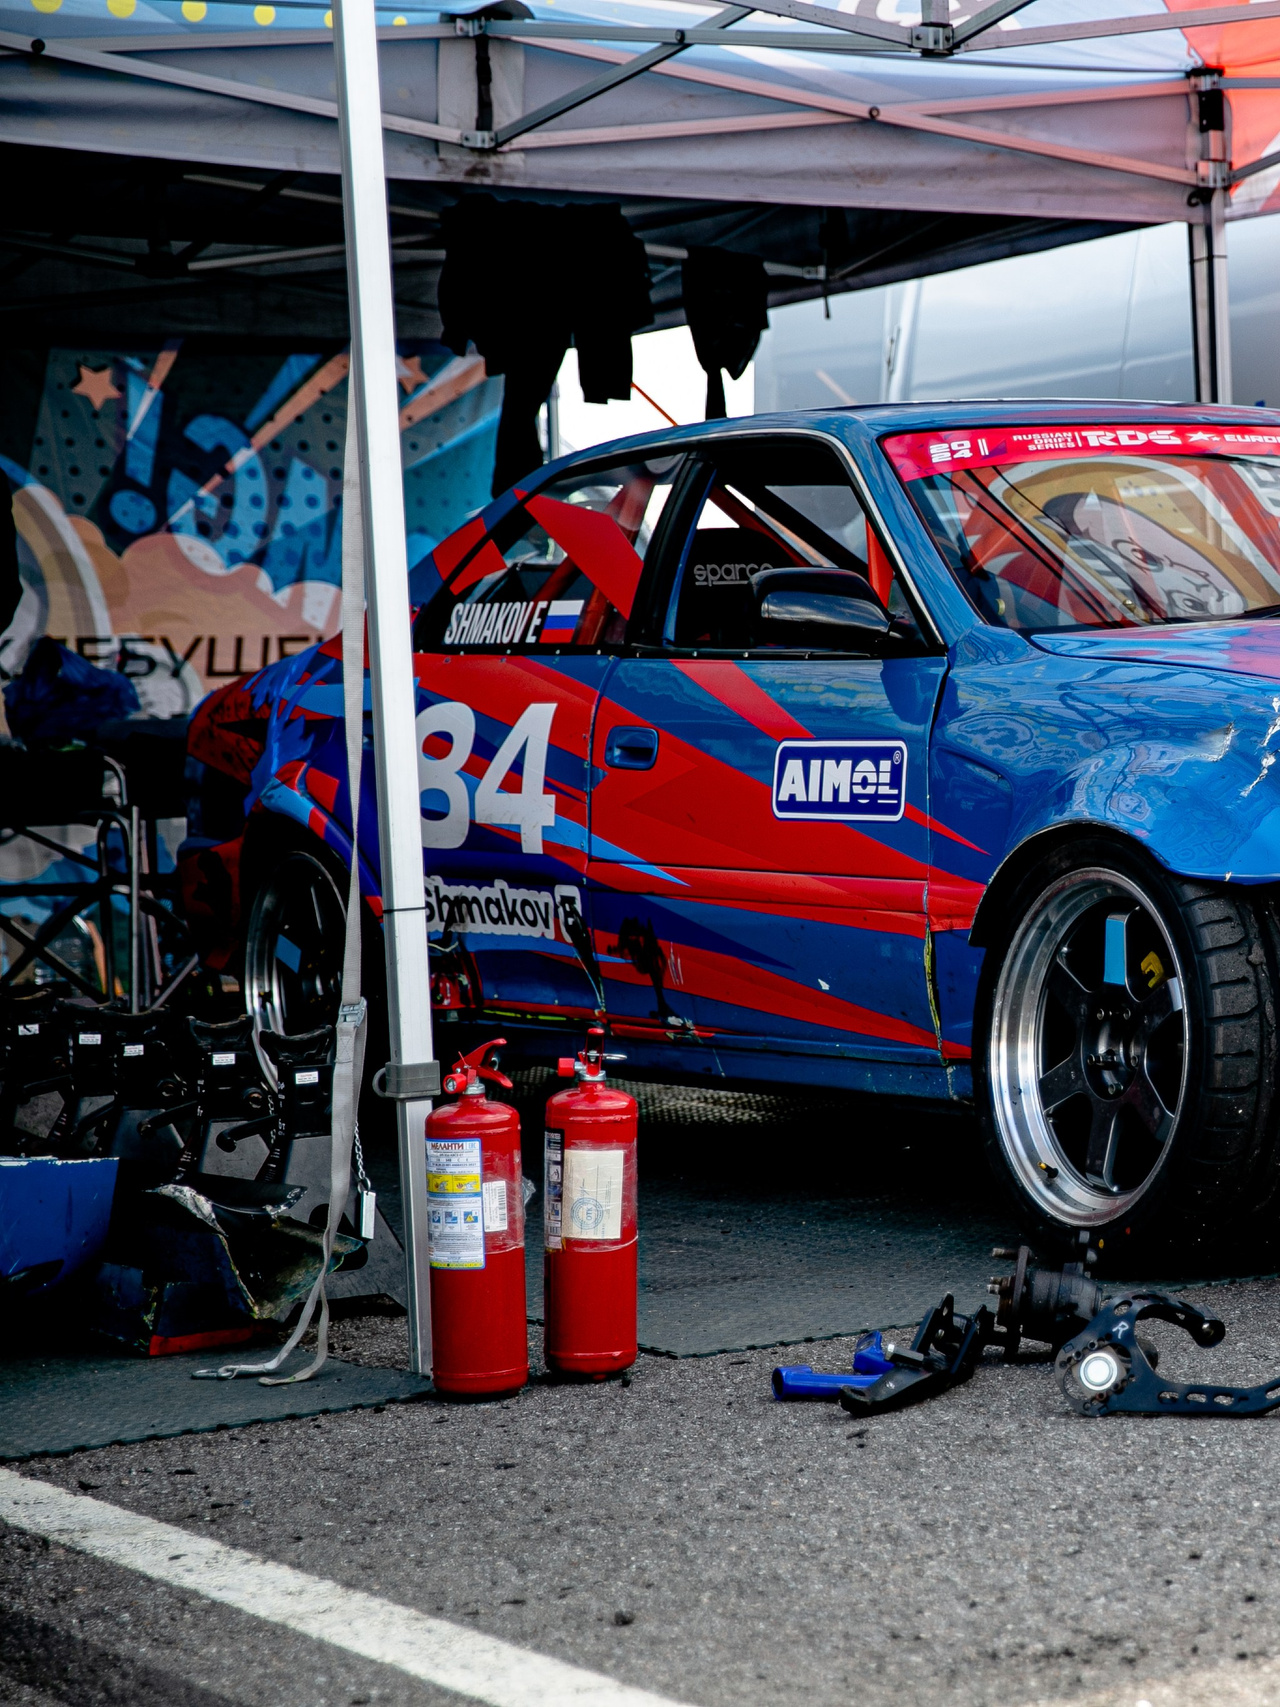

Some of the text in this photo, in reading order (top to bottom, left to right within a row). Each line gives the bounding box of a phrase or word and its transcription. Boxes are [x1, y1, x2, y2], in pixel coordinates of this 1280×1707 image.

[1012, 432, 1073, 441] RUSSIAN
[1034, 437, 1073, 445] DRIFT
[1081, 430, 1182, 447] RDS
[929, 440, 971, 454] 20
[1027, 442, 1076, 451] SERIES
[931, 449, 973, 463] 24
[444, 600, 549, 644] SHMAKOV E
[415, 701, 558, 854] 84
[777, 759, 899, 804] AIMOL
[1112, 1321, 1129, 1339] R
